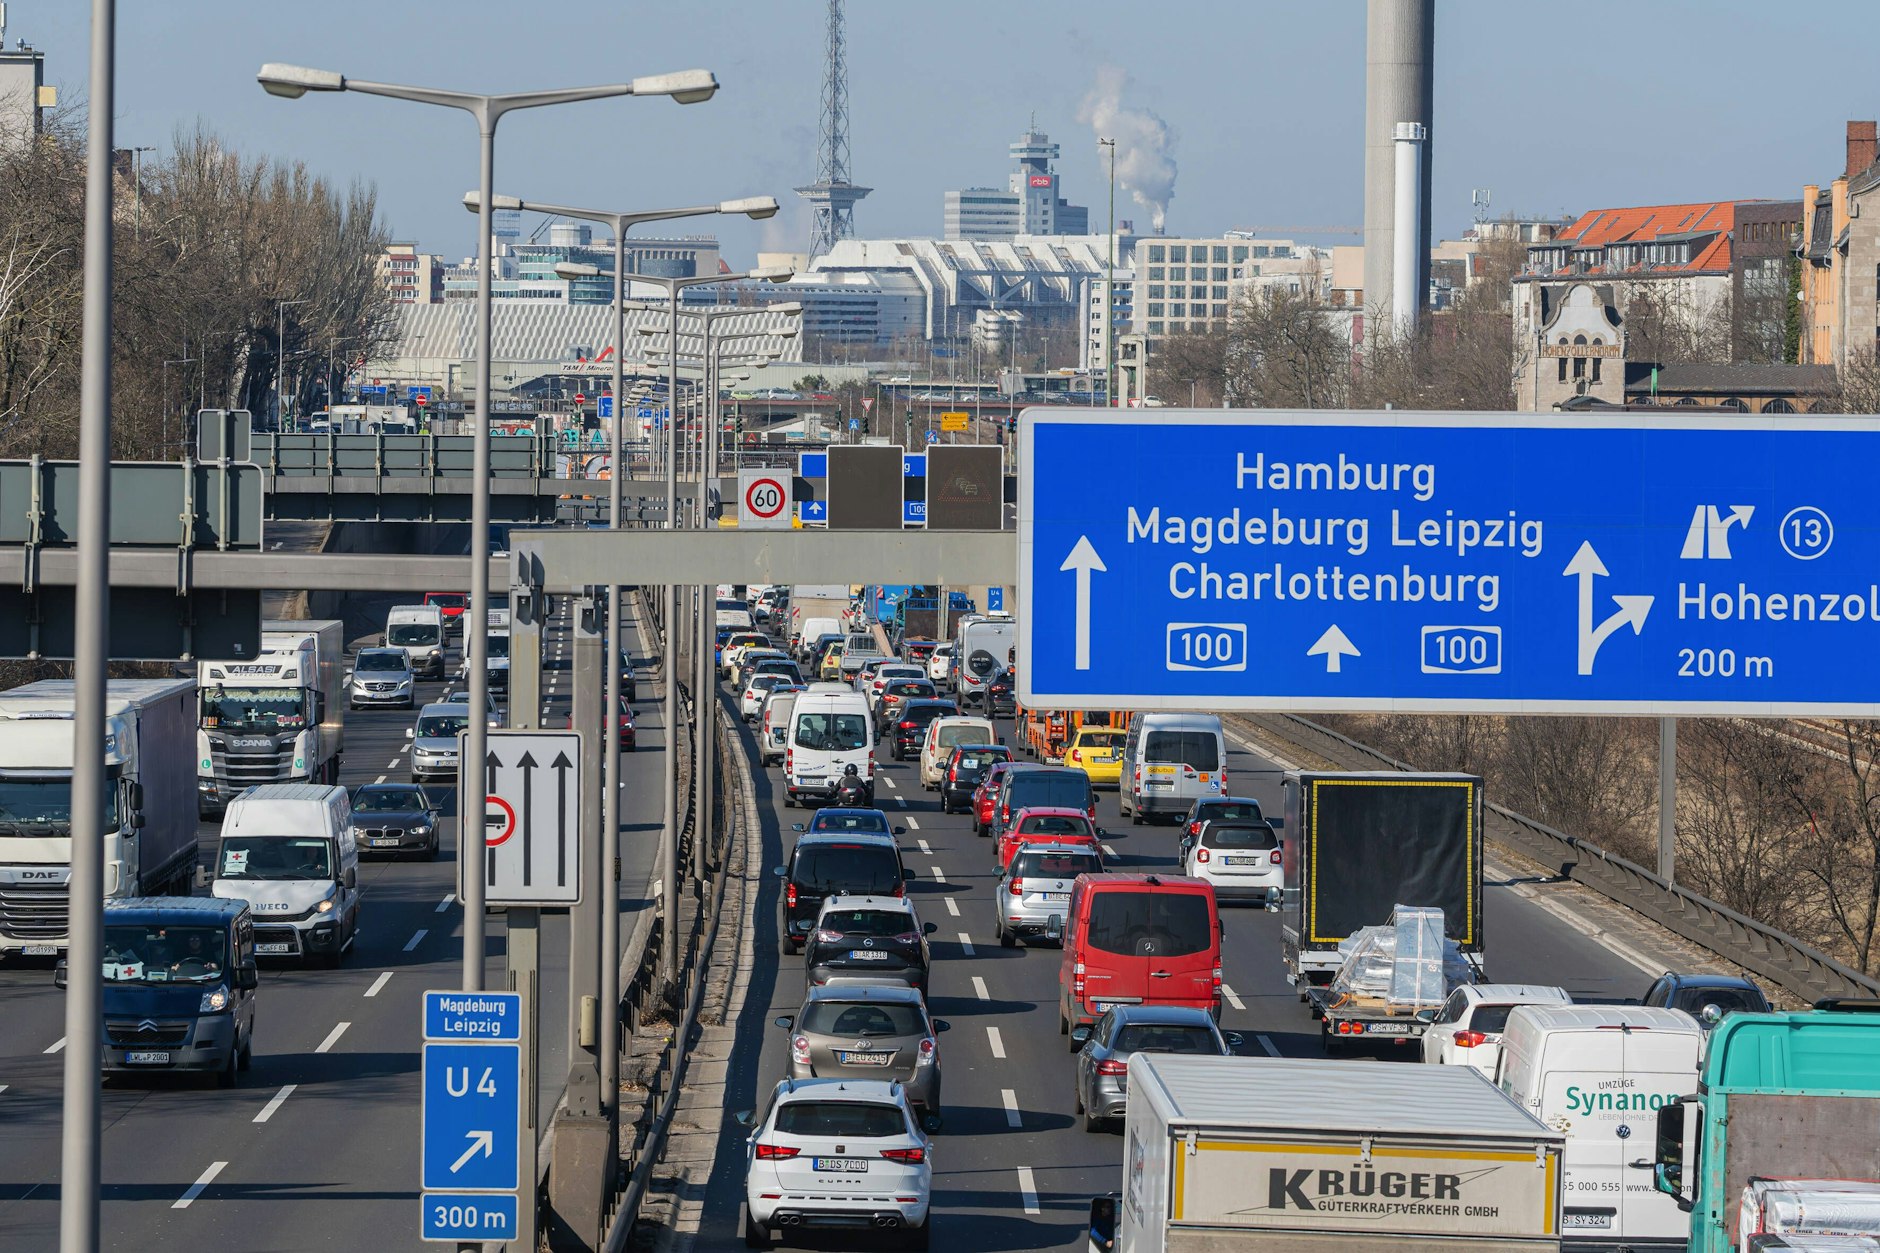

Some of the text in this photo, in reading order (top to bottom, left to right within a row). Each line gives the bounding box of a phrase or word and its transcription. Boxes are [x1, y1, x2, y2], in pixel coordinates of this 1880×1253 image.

[1032, 178, 1049, 186] rbb
[1236, 452, 1436, 501] Hamburg
[754, 489, 778, 508] 60
[1126, 506, 1544, 558] Magdeburg Leipzig
[1790, 518, 1822, 548] 13
[1168, 561, 1501, 613] Charlottenburg
[1677, 582, 1880, 622] Hohenzol
[1180, 632, 1233, 662] 100
[1435, 634, 1488, 665] 100
[1677, 647, 1774, 678] 200 m
[232, 739, 273, 747] SCANIA
[22, 871, 59, 879] DAF
[255, 903, 289, 911] IVECO
[853, 951, 859, 959] B
[439, 997, 506, 1016] Magdeburg
[444, 1017, 501, 1036] Leipzig
[152, 1053, 168, 1061] 2001
[845, 1053, 852, 1062] B
[867, 1053, 886, 1063] 2415
[446, 1066, 497, 1098] U 4
[1598, 1078, 1635, 1090] UMZÜGE
[1598, 1113, 1622, 1121] LEBEN
[1625, 1113, 1646, 1121] OHNE
[819, 1160, 825, 1168] B
[830, 1160, 842, 1169] DS
[1268, 1162, 1460, 1211] KRÜGER
[1578, 1181, 1598, 1191] 000
[1601, 1182, 1620, 1192] 555
[434, 1206, 506, 1228] 300 m
[1317, 1199, 1499, 1218] GÜTERKRAFTVERKEHR GMBH
[1574, 1216, 1586, 1225] SY
[1588, 1216, 1605, 1225] 324
